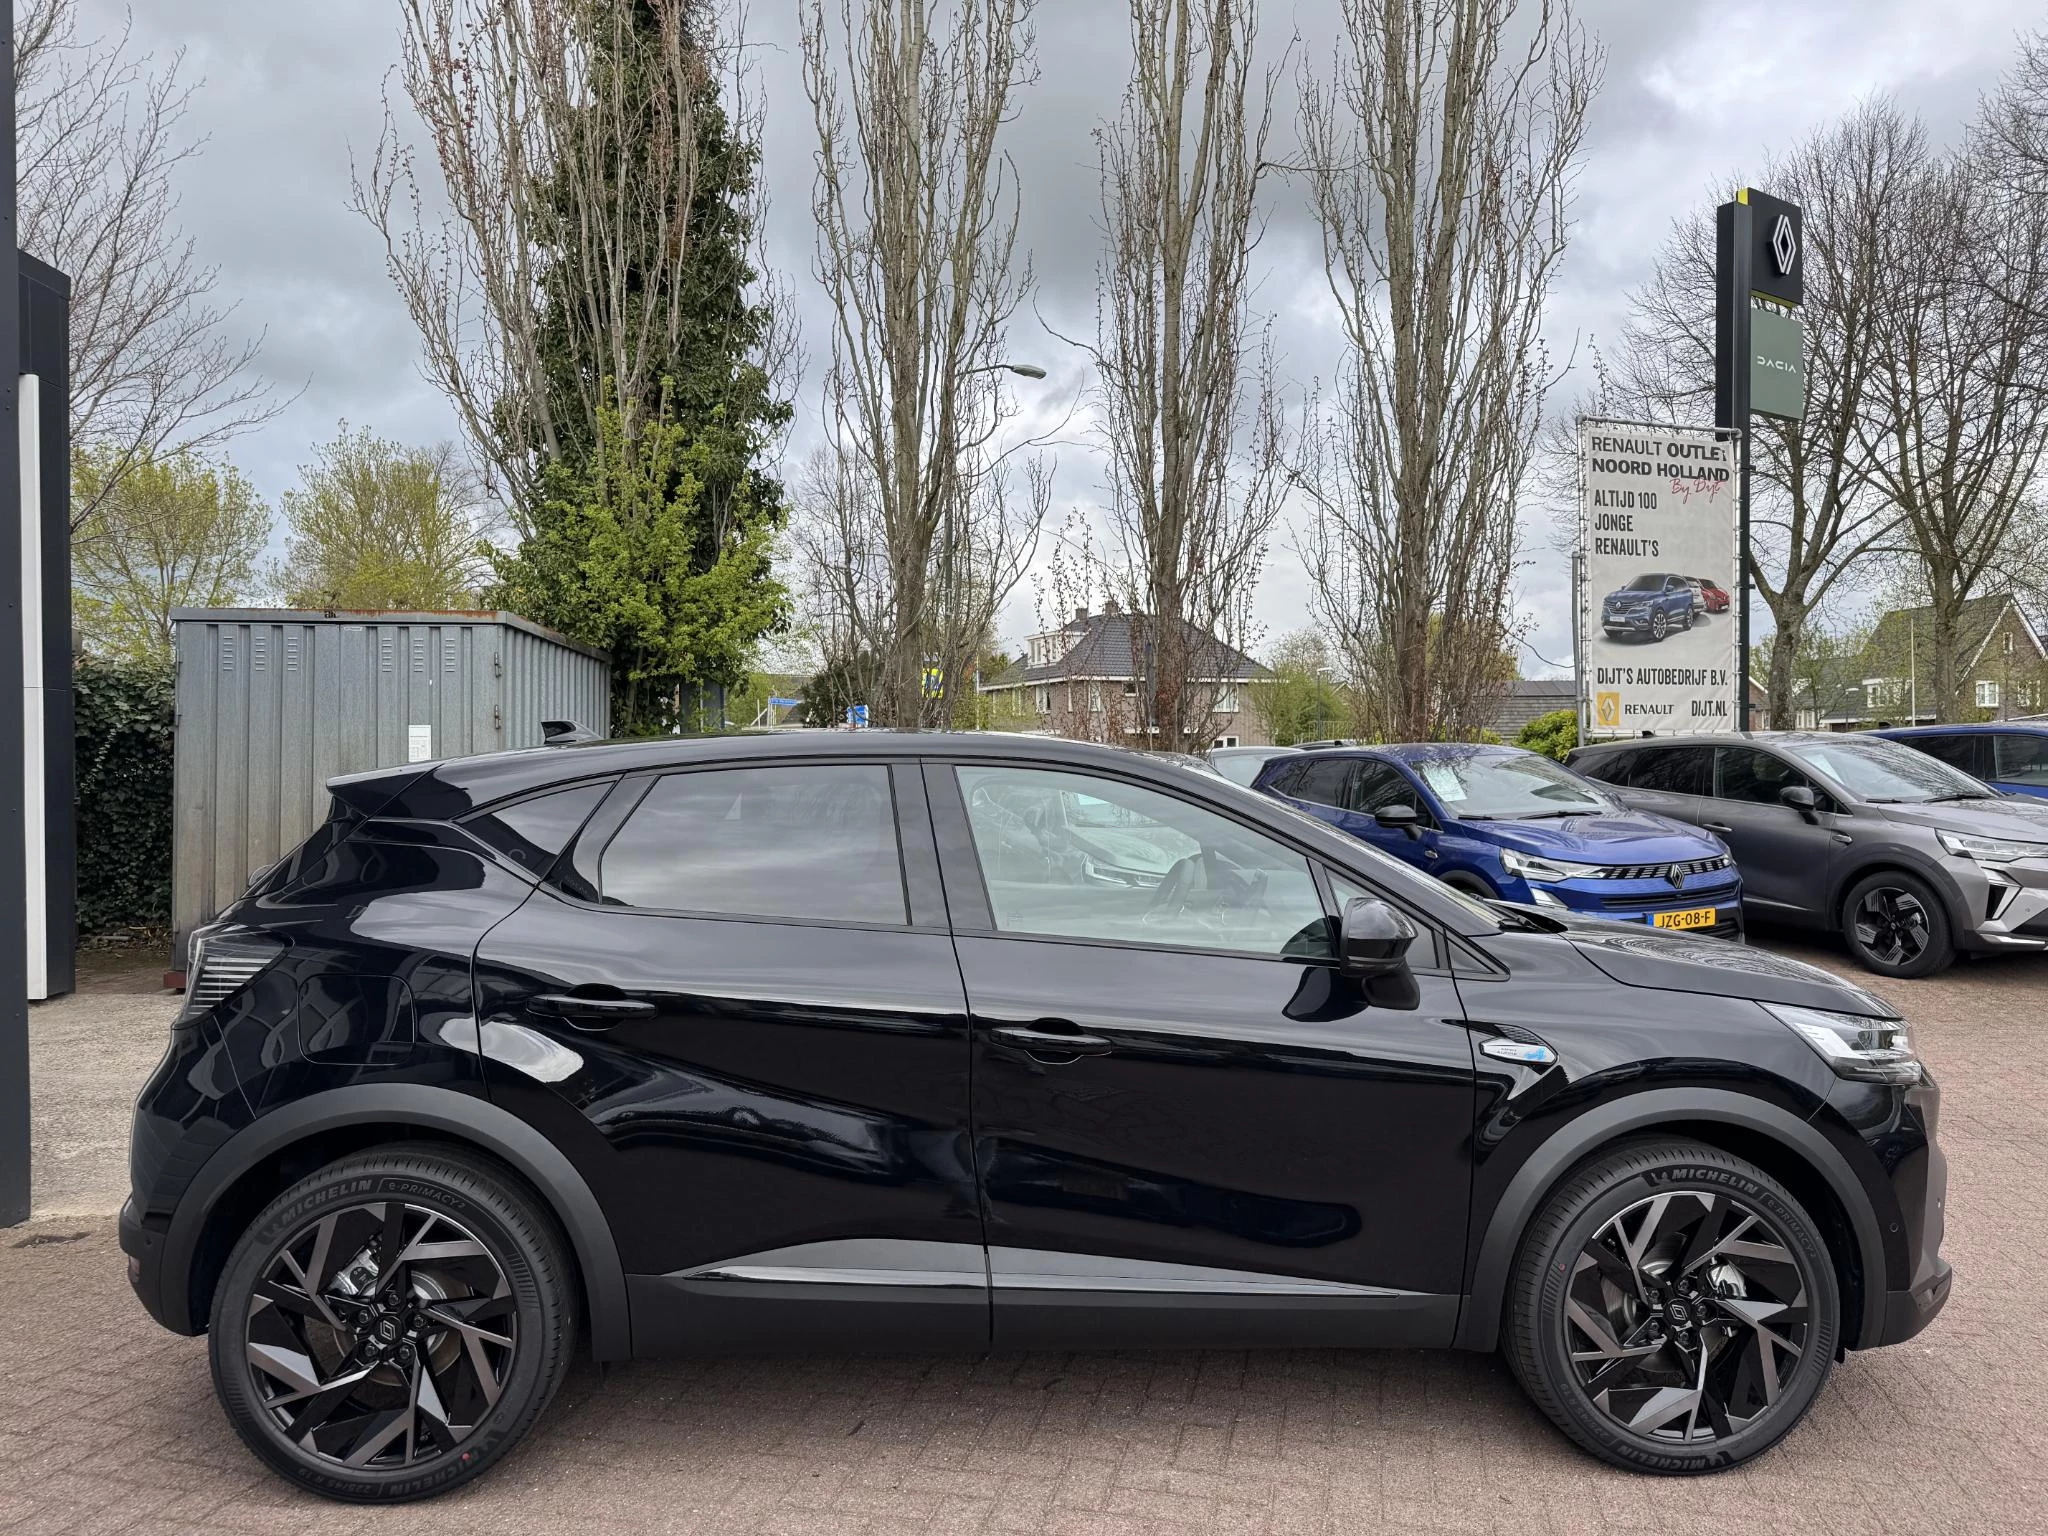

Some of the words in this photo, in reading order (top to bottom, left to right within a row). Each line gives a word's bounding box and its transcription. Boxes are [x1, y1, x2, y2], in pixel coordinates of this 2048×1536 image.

[1757, 355, 1796, 374] DACIA
[1592, 436, 1662, 456] RENAULT
[1592, 458, 1651, 475] NOORD
[1657, 462, 1730, 482] HOLLAND
[1594, 489, 1635, 508] ALTIJD
[1637, 492, 1657, 509] 100
[1670, 478, 1691, 504] By
[1594, 513, 1633, 532] JONGE
[1595, 537, 1659, 557] RENAULT'S
[1597, 667, 1633, 685] DIJT'S
[1636, 668, 1707, 686] AUTOBEDRIJF
[1710, 670, 1728, 686] B.V.
[1624, 703, 1674, 715] RENAULT
[1691, 700, 1728, 717] DIJT.NL
[1659, 911, 1711, 928] JZG-08-F
[1671, 1168, 1758, 1194] MICHELIN
[281, 1179, 373, 1225] MICHELIN
[1616, 1445, 1705, 1469] MICHELIN
